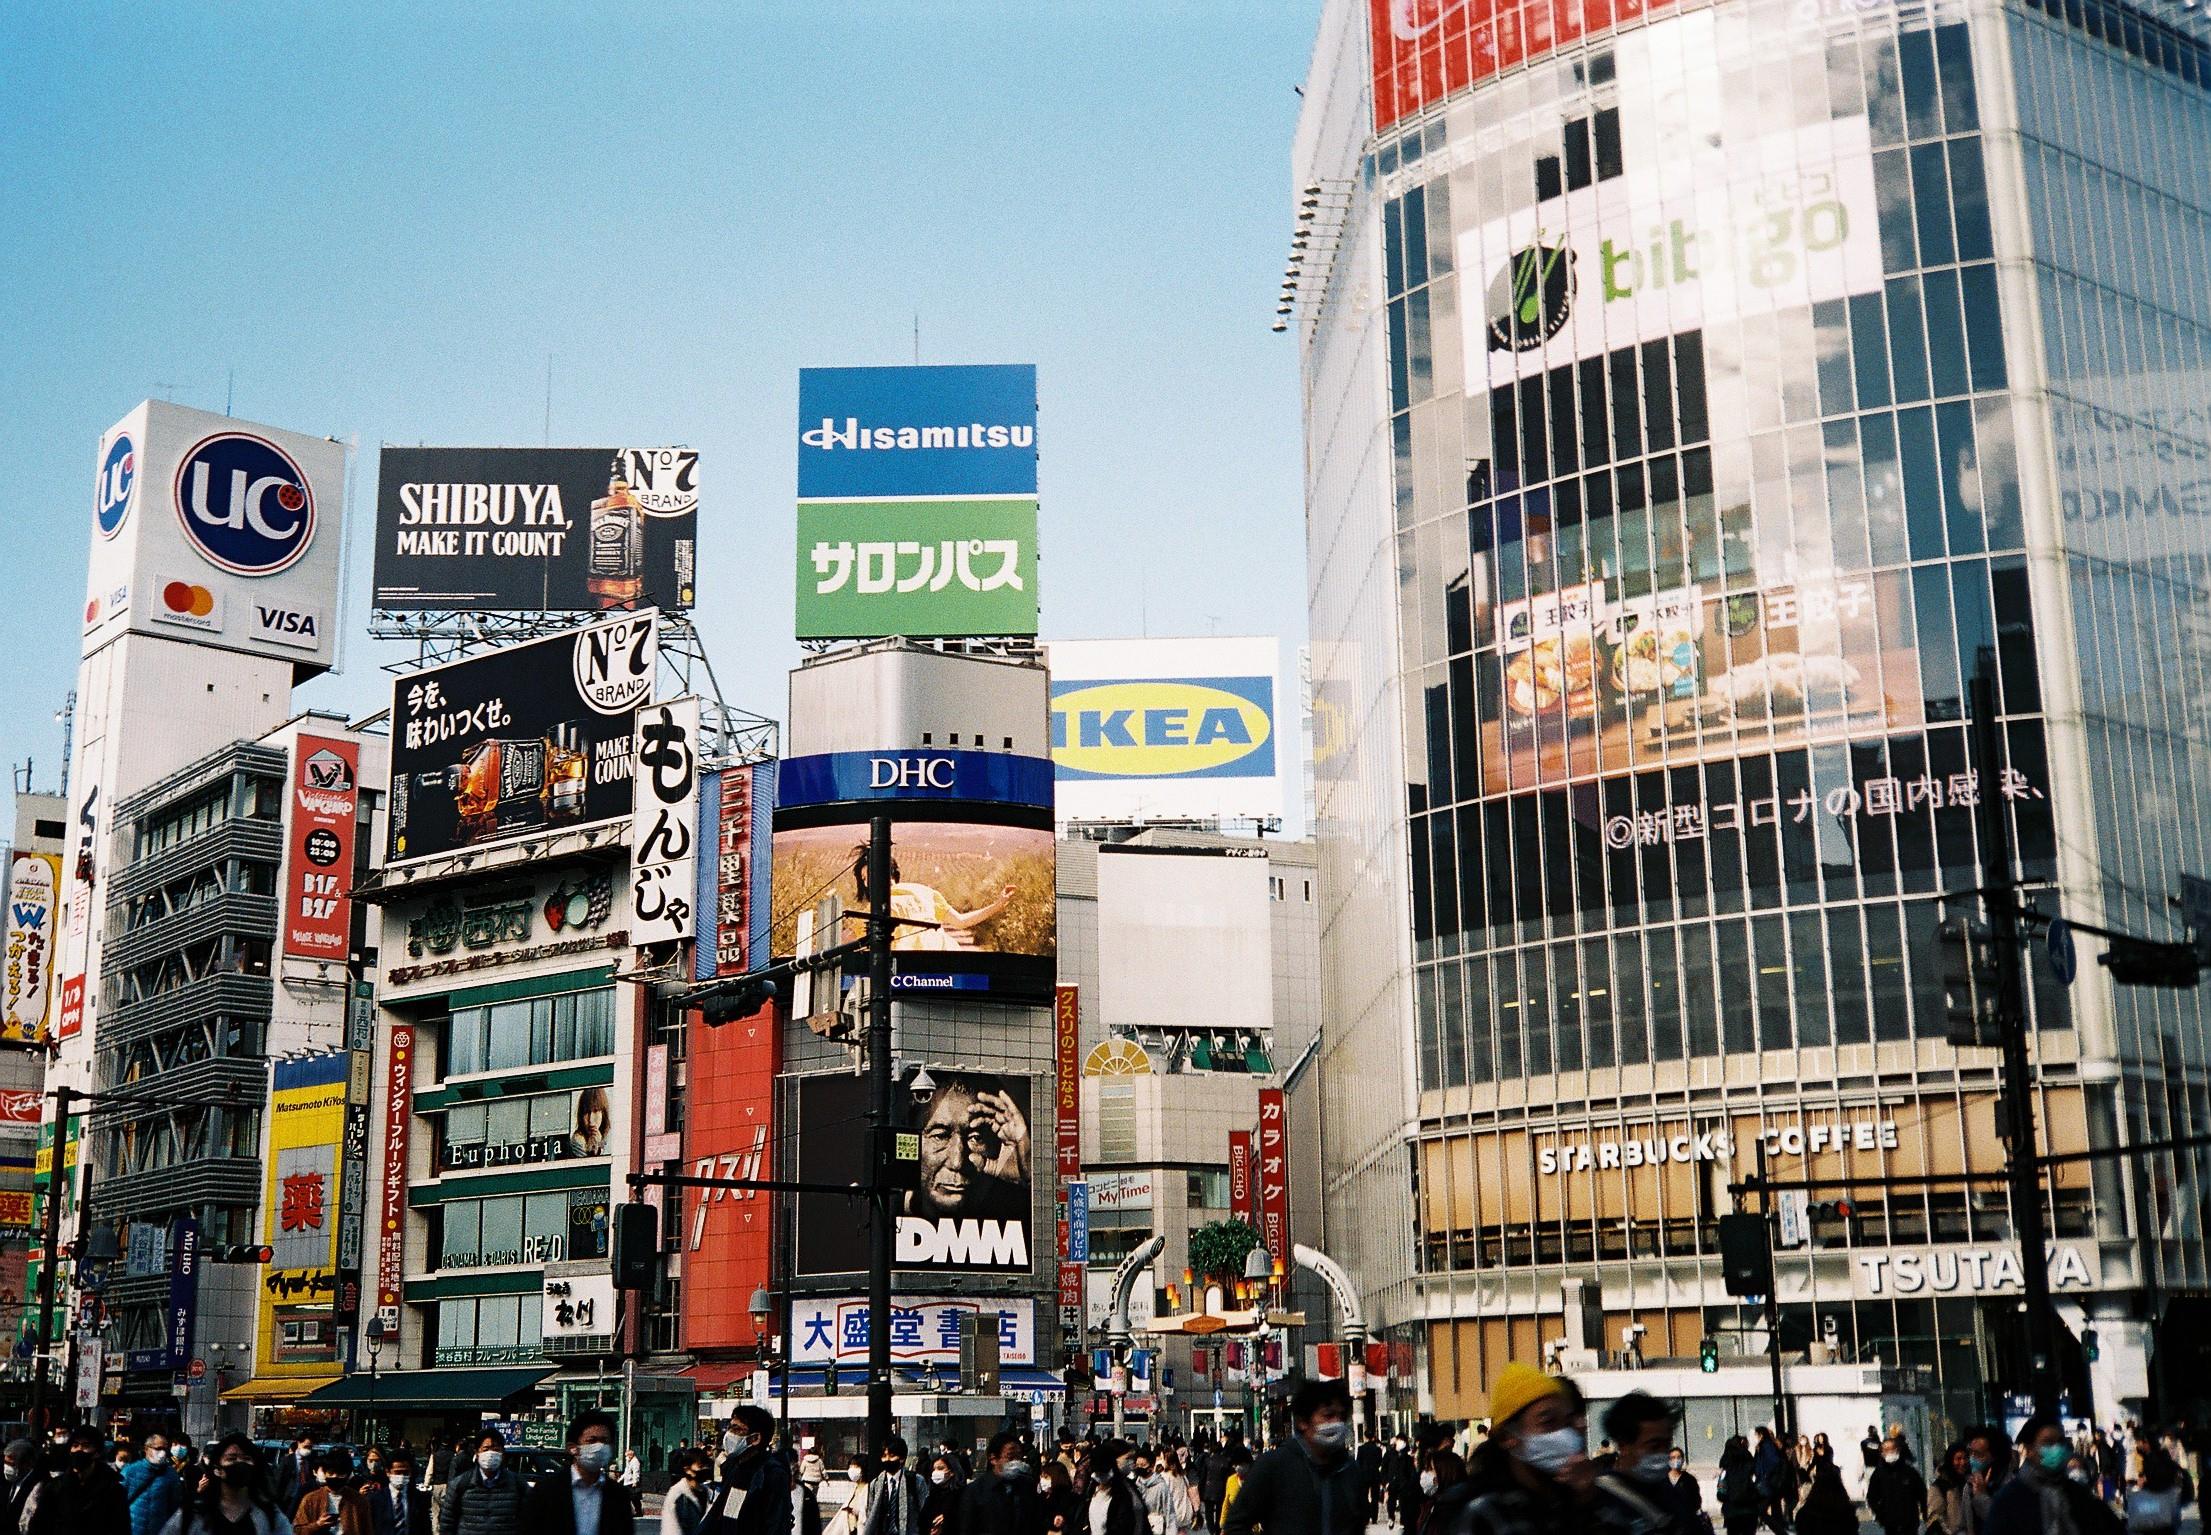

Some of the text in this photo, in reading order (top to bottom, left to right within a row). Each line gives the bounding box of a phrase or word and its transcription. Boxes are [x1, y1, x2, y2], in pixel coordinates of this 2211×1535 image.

[1601, 200, 1849, 303] bibgo
[802, 417, 1033, 450] Hisamitsu
[399, 482, 574, 531] SHIBUYA,
[641, 494, 692, 508] BRAND
[396, 531, 566, 556] MAKE IT COUNT
[811, 540, 1023, 594] サロンパス
[256, 605, 317, 638] VISA
[408, 681, 447, 716] 今を、
[595, 678, 645, 701] BRAND
[405, 698, 512, 750] 味わいつくせ。
[1051, 707, 1253, 748] IKEA
[595, 736, 630, 761] MAKE
[869, 758, 955, 789] DHC
[635, 706, 694, 934] もんじゃ
[303, 873, 338, 895] B1F
[717, 773, 744, 965] 三千里薬品
[12, 903, 47, 930] W
[301, 896, 339, 920] B2F
[902, 975, 954, 988] Channel
[1061, 991, 1075, 1110] クスリのことなら
[275, 1100, 322, 1114] Matsumoto
[387, 1063, 406, 1218] ウィンターフルーツギフト
[450, 1136, 562, 1168] Euphoria
[1263, 1102, 1283, 1200] カラオケ
[1540, 1119, 1899, 1175] STARBUCKS COFFEE
[281, 1171, 325, 1233] 薬
[895, 1216, 1029, 1266] DMM
[1859, 1246, 2092, 1294] TSUTAA
[1061, 1272, 1079, 1304] 焼肉
[175, 1307, 187, 1356] みずほ銀行
[803, 1308, 1018, 1350] 大盛堂書店
[438, 1348, 544, 1363] 渋谷西村 フルーツパーラー
[525, 1426, 559, 1436] One Family
[525, 1433, 544, 1441] Under
